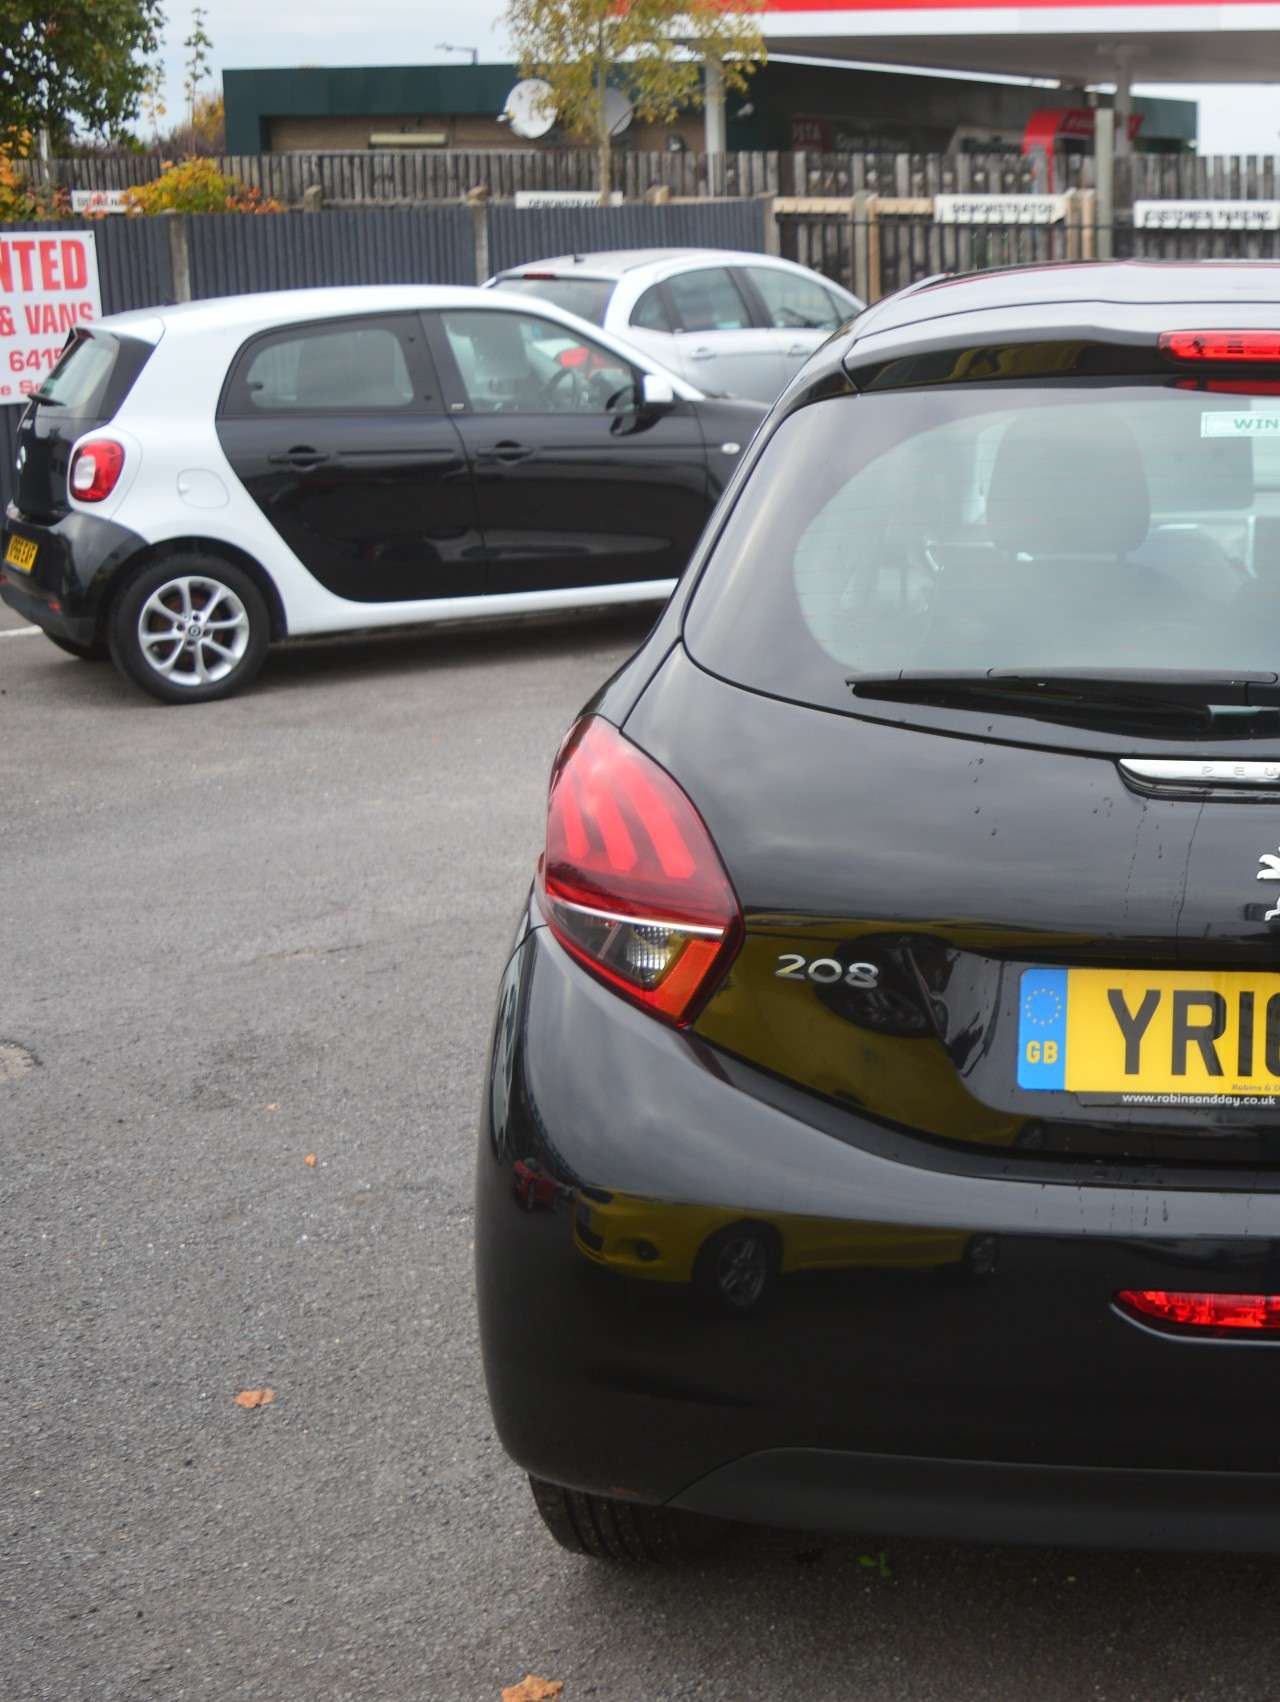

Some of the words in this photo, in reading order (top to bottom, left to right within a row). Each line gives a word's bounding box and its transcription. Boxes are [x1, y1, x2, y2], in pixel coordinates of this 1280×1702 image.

[952, 202, 1055, 213] DEMONSTRATOR
[1144, 209, 1212, 222] CUSTOMER
[1219, 209, 1272, 222] PARKING
[775, 953, 880, 989] 208
[1026, 1040, 1058, 1065] GB
[1231, 1083, 1262, 1092] Robins
[1122, 1092, 1276, 1107] www.robinsandday.co.uk
